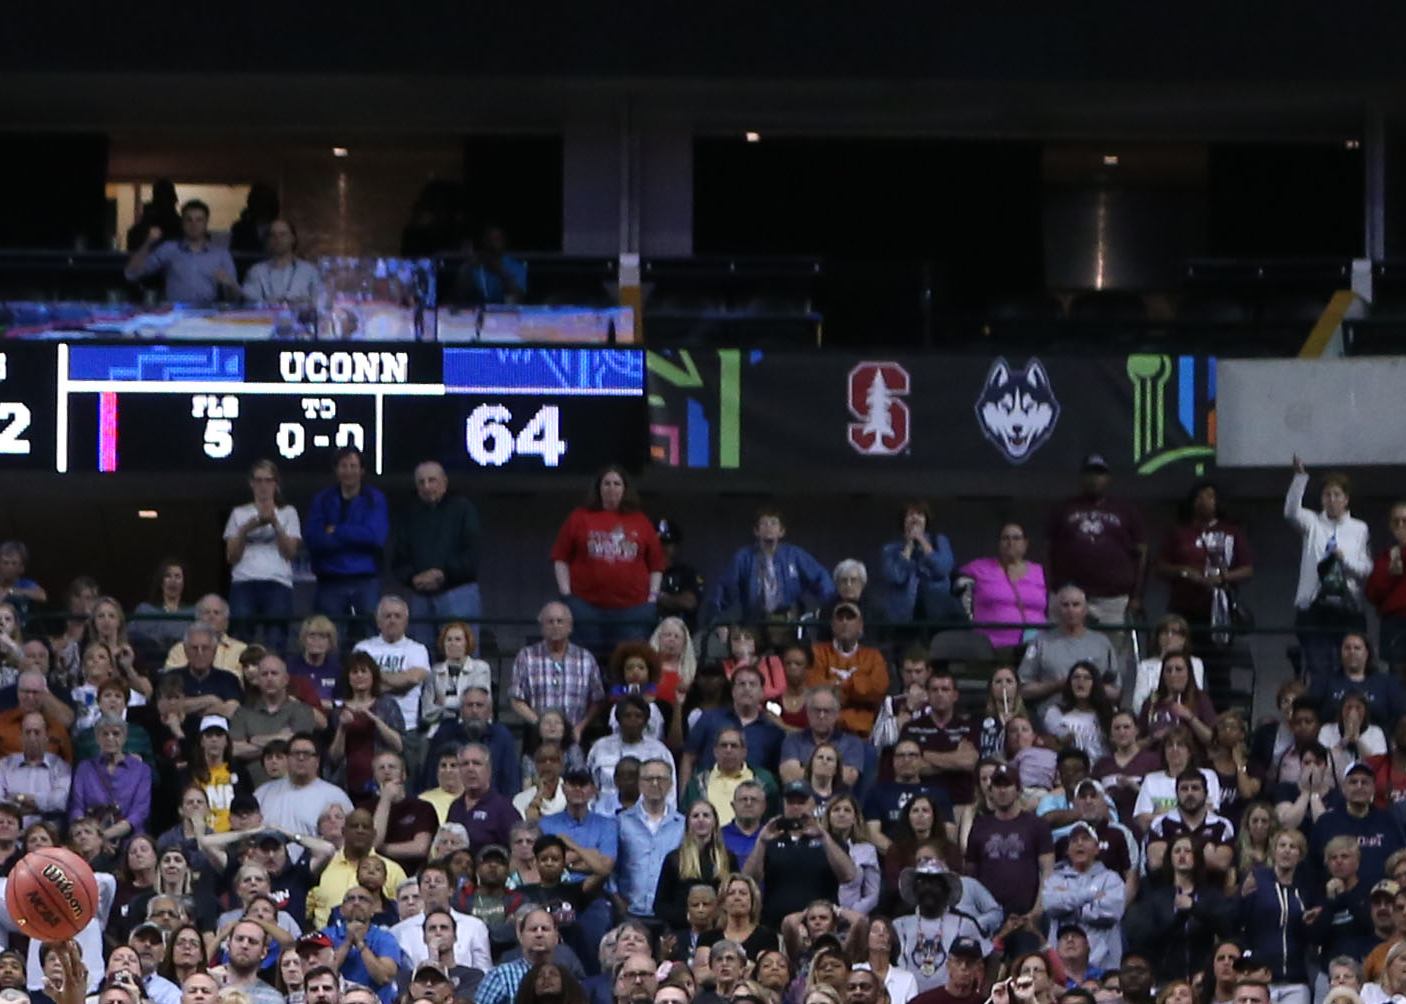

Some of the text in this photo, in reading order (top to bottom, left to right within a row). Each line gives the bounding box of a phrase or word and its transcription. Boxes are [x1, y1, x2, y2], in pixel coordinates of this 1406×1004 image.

[279, 351, 409, 383] UCONN
[203, 418, 233, 458] 5
[466, 402, 566, 466] 64
[41, 863, 83, 920] Wilson
